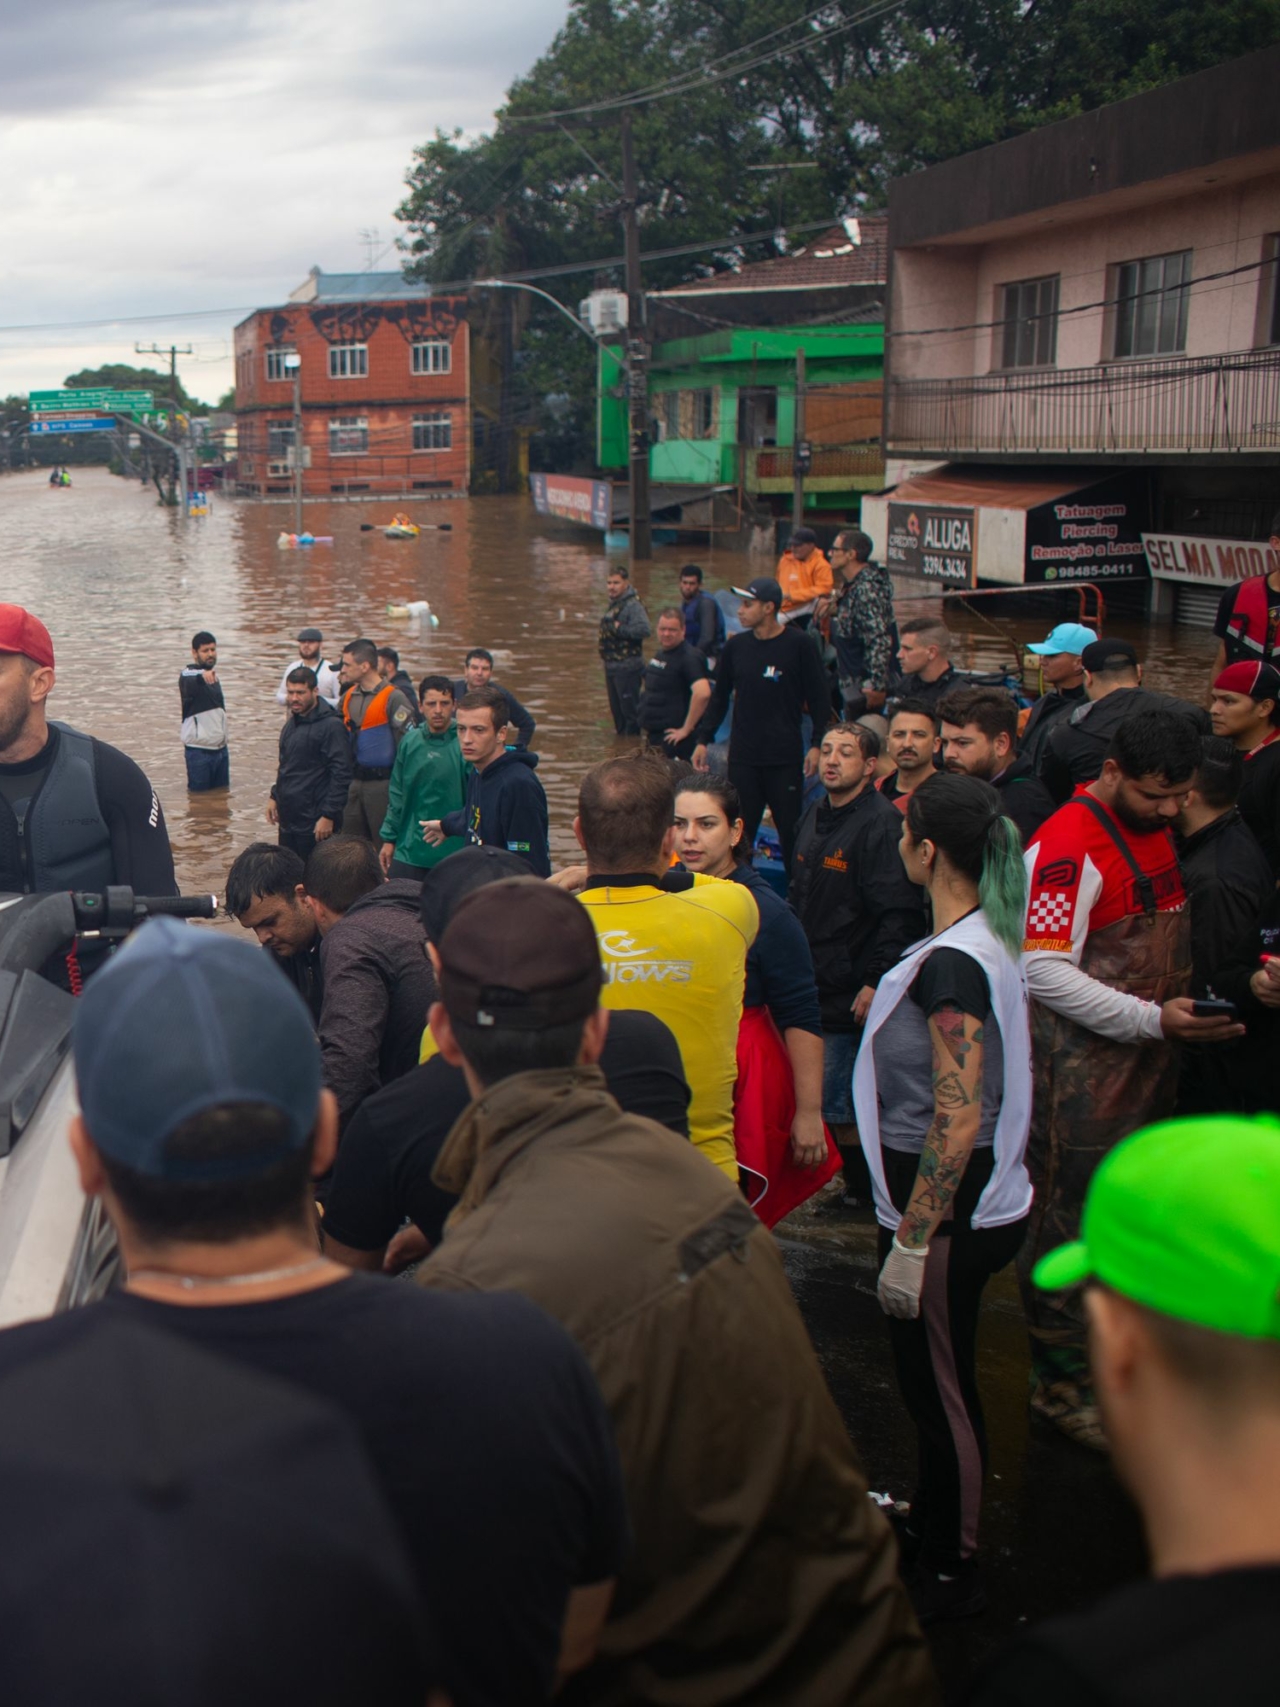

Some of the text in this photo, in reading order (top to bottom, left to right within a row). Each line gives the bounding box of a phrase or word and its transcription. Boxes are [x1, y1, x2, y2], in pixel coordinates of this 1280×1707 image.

[1054, 504, 1126, 519] Tatuagem
[923, 518, 972, 551] ALUGA
[1061, 523, 1118, 539] Piercing
[889, 548, 907, 560] REAL
[1031, 541, 1144, 560] Remoção a Laser
[1145, 539, 1215, 577] SELMA
[1058, 564, 1133, 578] 98485-0411
